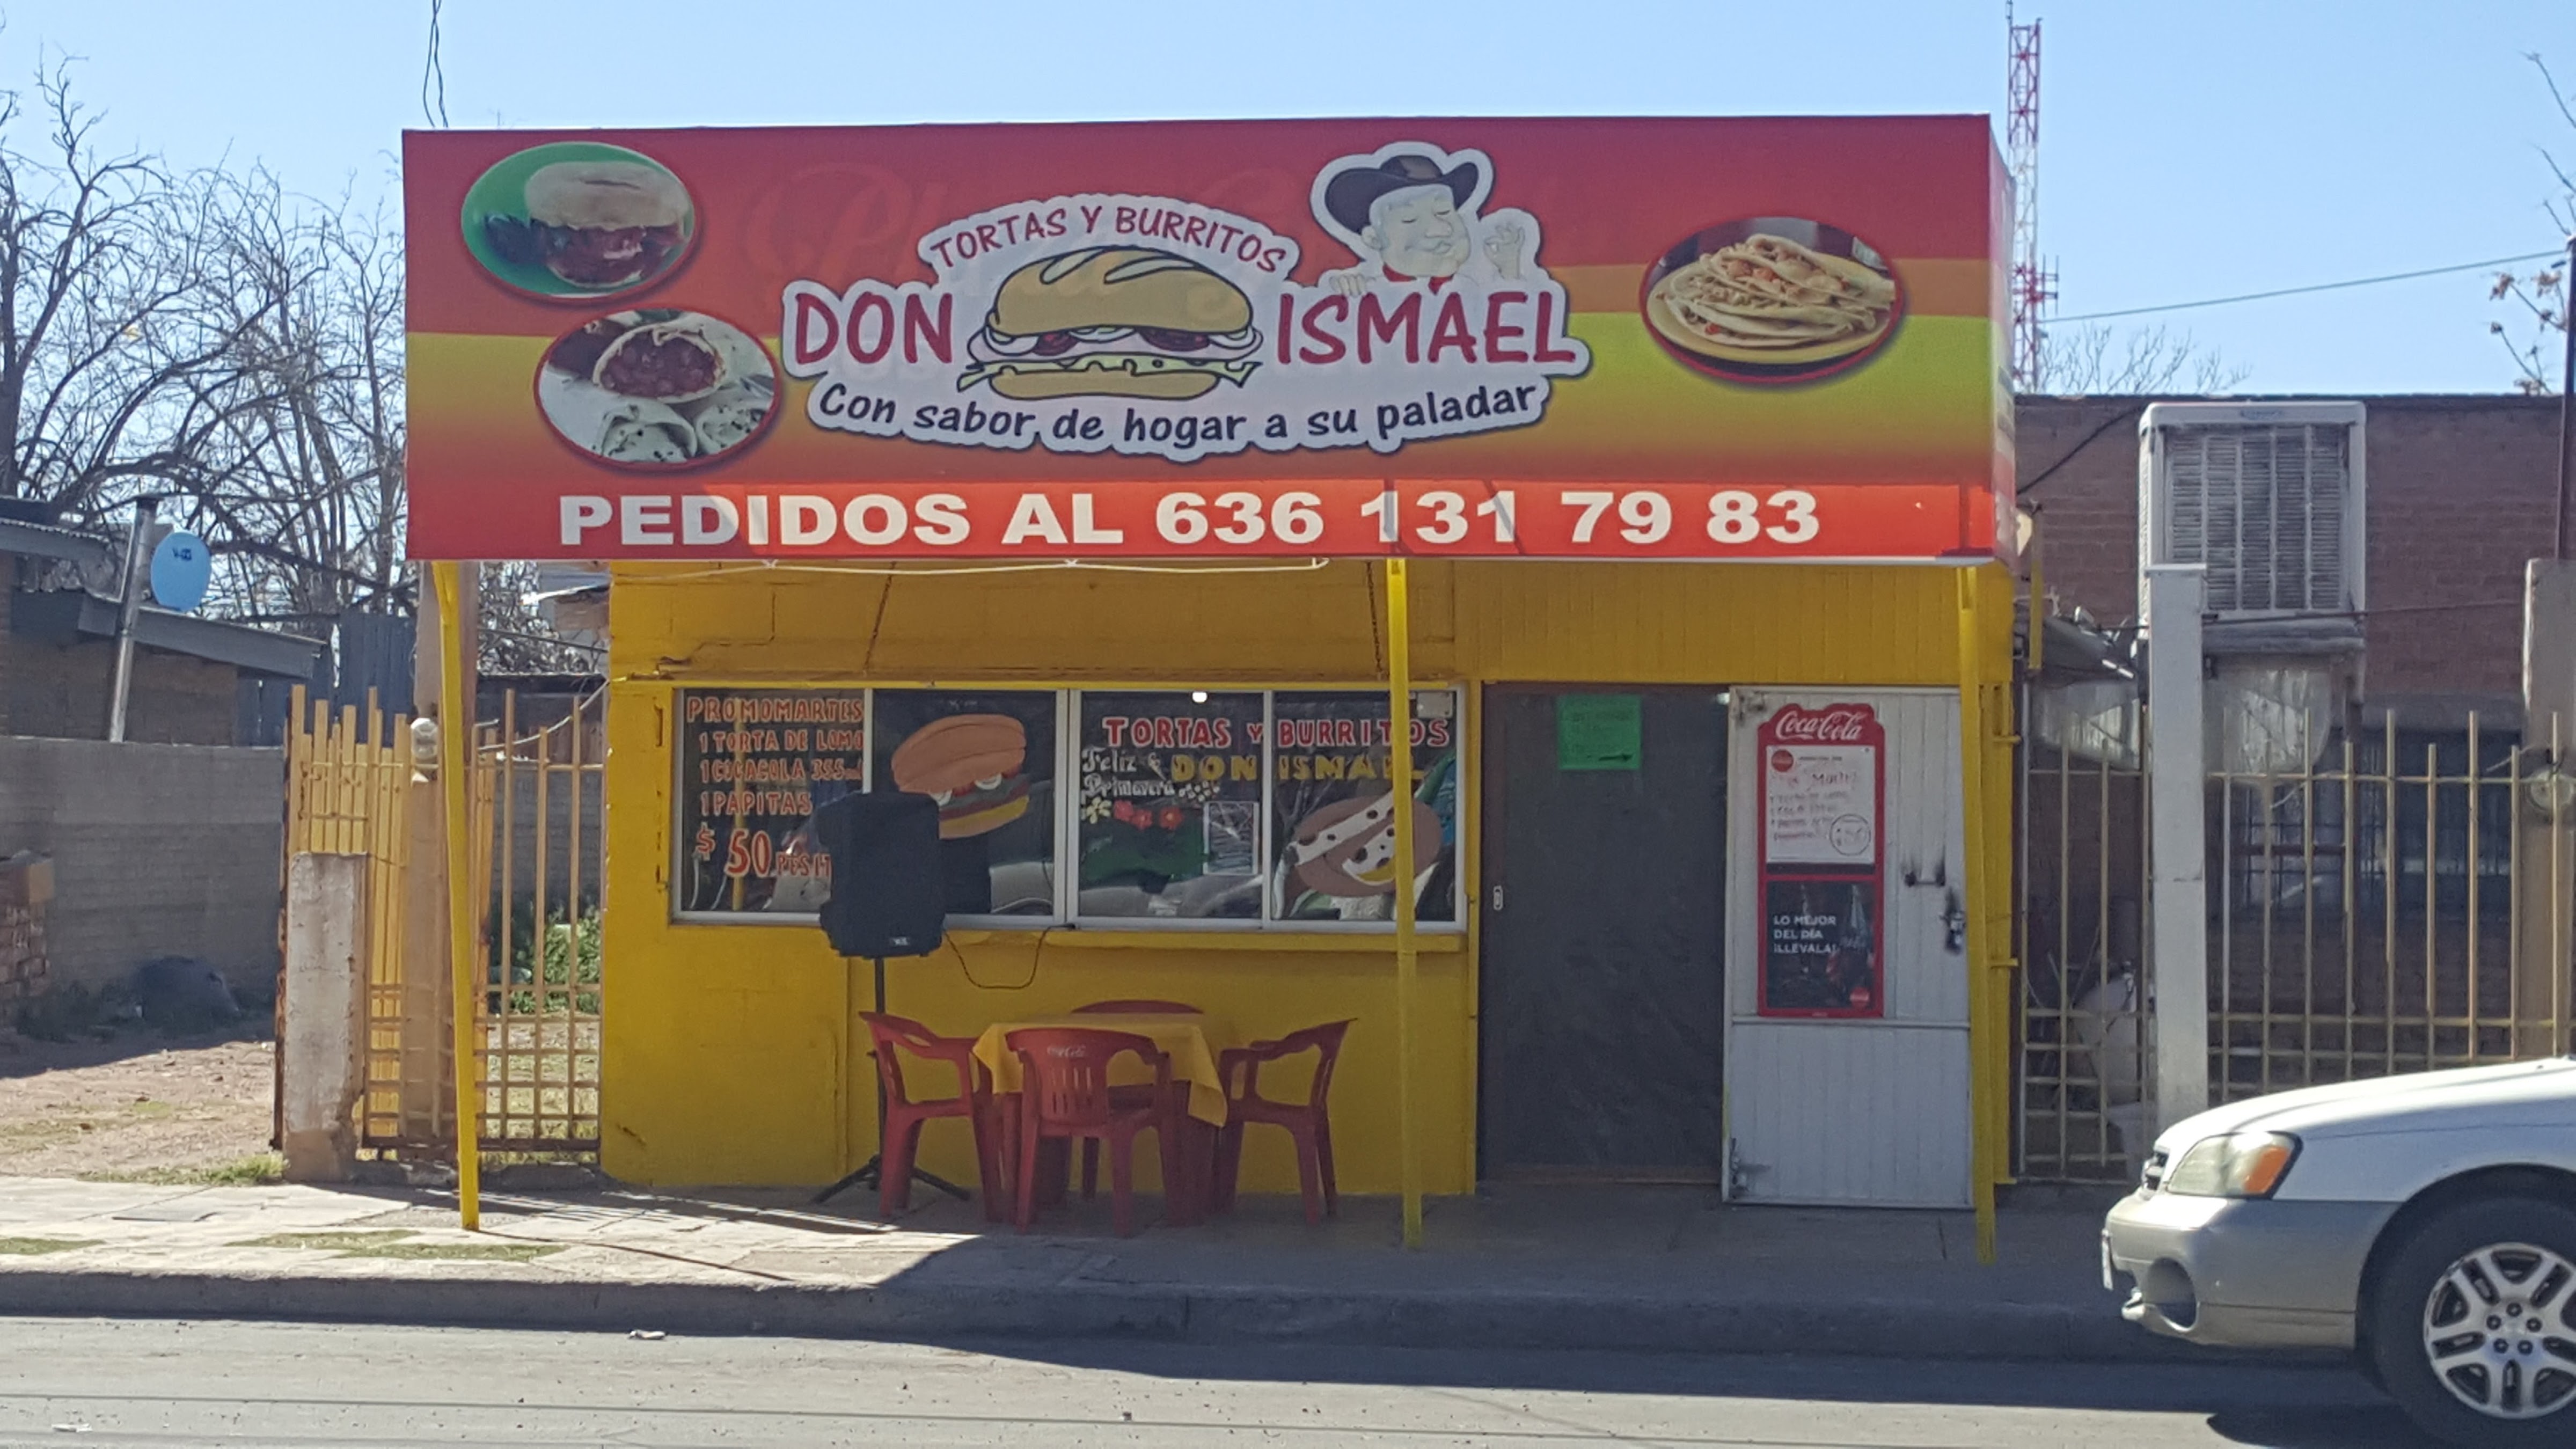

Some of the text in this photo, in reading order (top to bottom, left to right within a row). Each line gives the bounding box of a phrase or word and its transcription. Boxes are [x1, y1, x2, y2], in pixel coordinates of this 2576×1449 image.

[930, 208, 1067, 267] TORTAS
[1080, 206, 1103, 233] Y
[1115, 207, 1286, 273] BURRITOS
[793, 290, 1576, 365] DON ISMAEL
[818, 383, 1537, 449] Con sabor de hogar a su paladar
[560, 491, 1819, 546] PEDIDOS AL 636 131 79 83
[699, 729, 863, 752] 1 TORTA DE LOMO
[1102, 716, 1232, 748] TORTAS
[1277, 718, 1450, 747] BURRITOS
[1081, 745, 1137, 773] Feliz
[1170, 753, 1257, 782] DON
[713, 791, 813, 816] PAPITAS
[724, 828, 772, 877] 50
[1774, 915, 1836, 925] LO MEJOR
[1774, 930, 1798, 940] DEL
